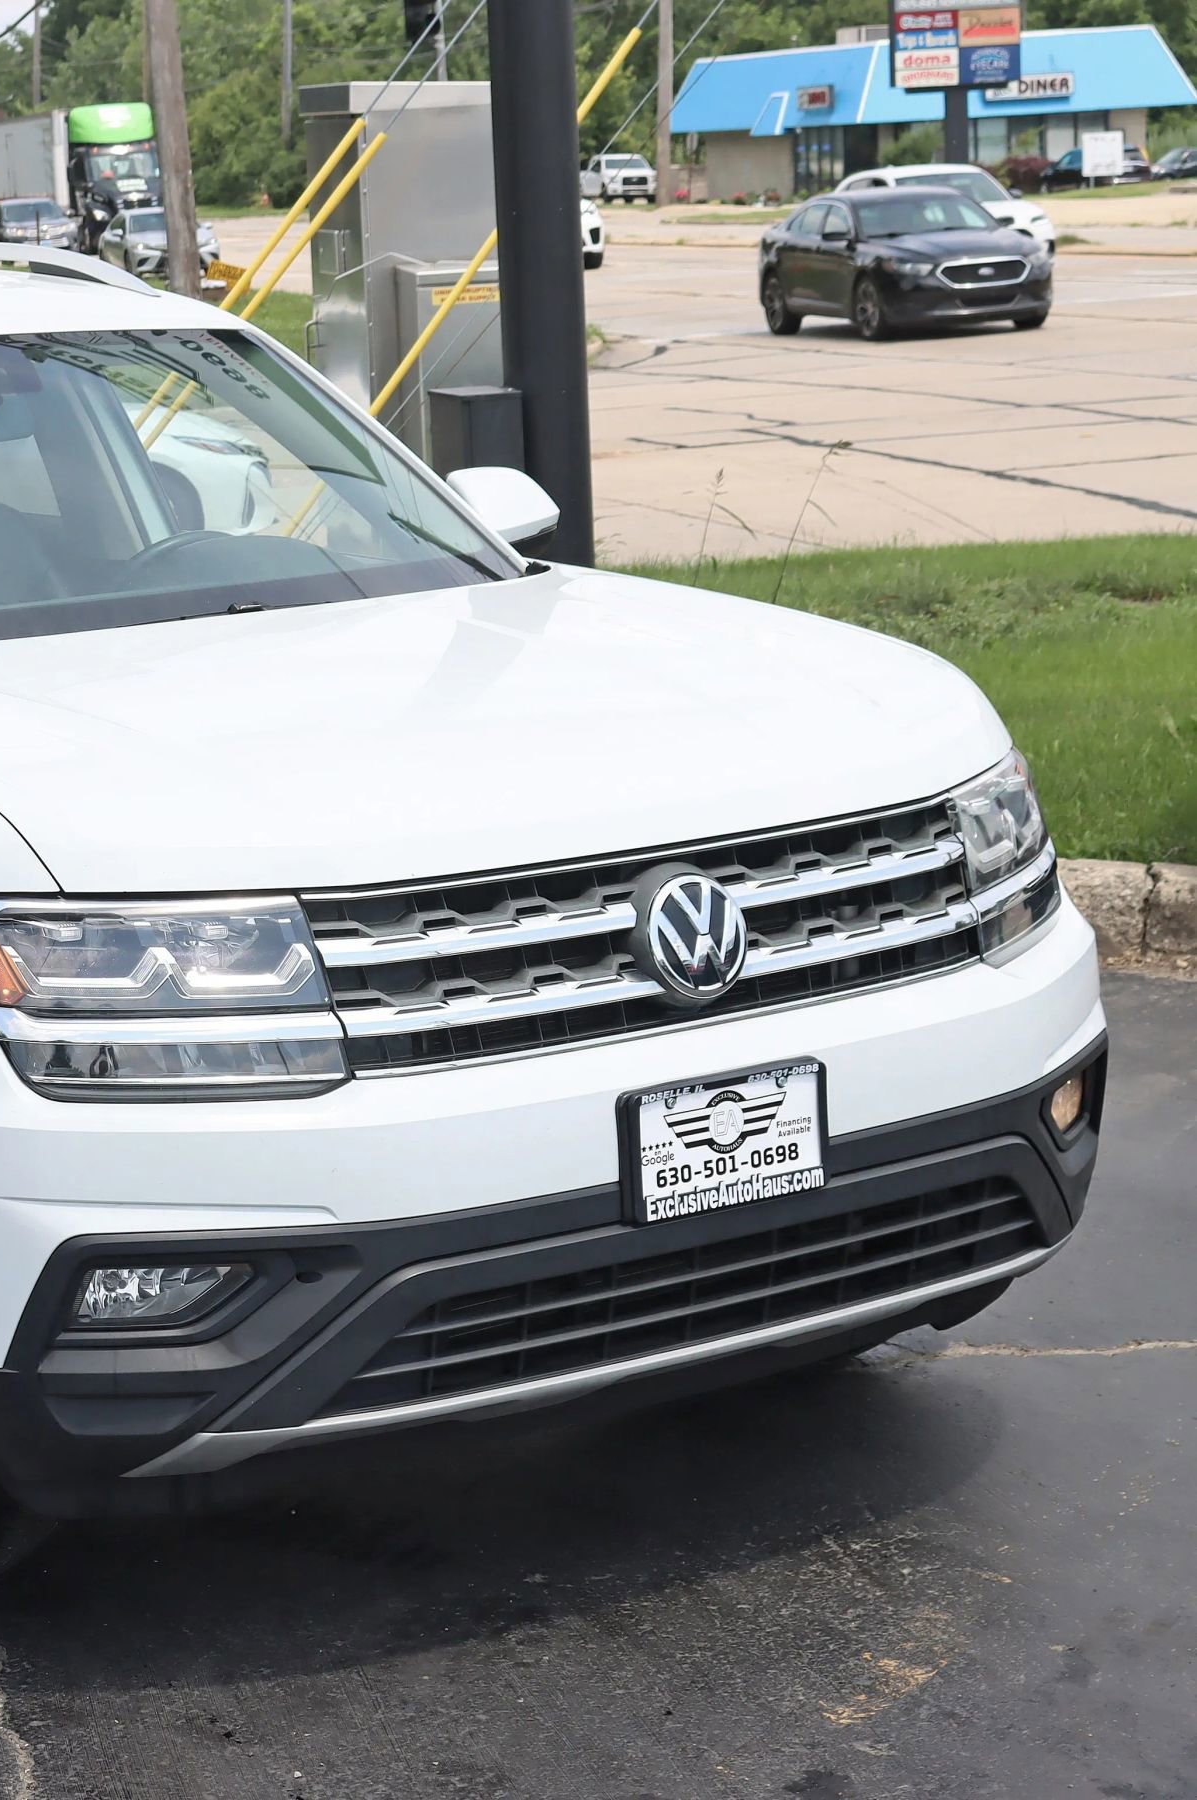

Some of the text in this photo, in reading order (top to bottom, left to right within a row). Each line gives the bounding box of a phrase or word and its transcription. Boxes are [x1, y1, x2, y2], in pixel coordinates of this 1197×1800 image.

[903, 55, 952, 68] doma
[1019, 78, 1070, 94] DINER
[747, 1063, 820, 1084] 630-501-0698
[694, 1084, 706, 1094] IL
[711, 1092, 741, 1106] EXCLUSIVE
[714, 1109, 741, 1137] EA
[776, 1116, 812, 1129] Financing
[777, 1125, 811, 1138] Available
[712, 1138, 743, 1152] AUTOHAUS
[641, 1150, 675, 1167] Google
[656, 1142, 799, 1189] 630-501-0698
[645, 1167, 825, 1222] ExclusiveAutoHaus.com
